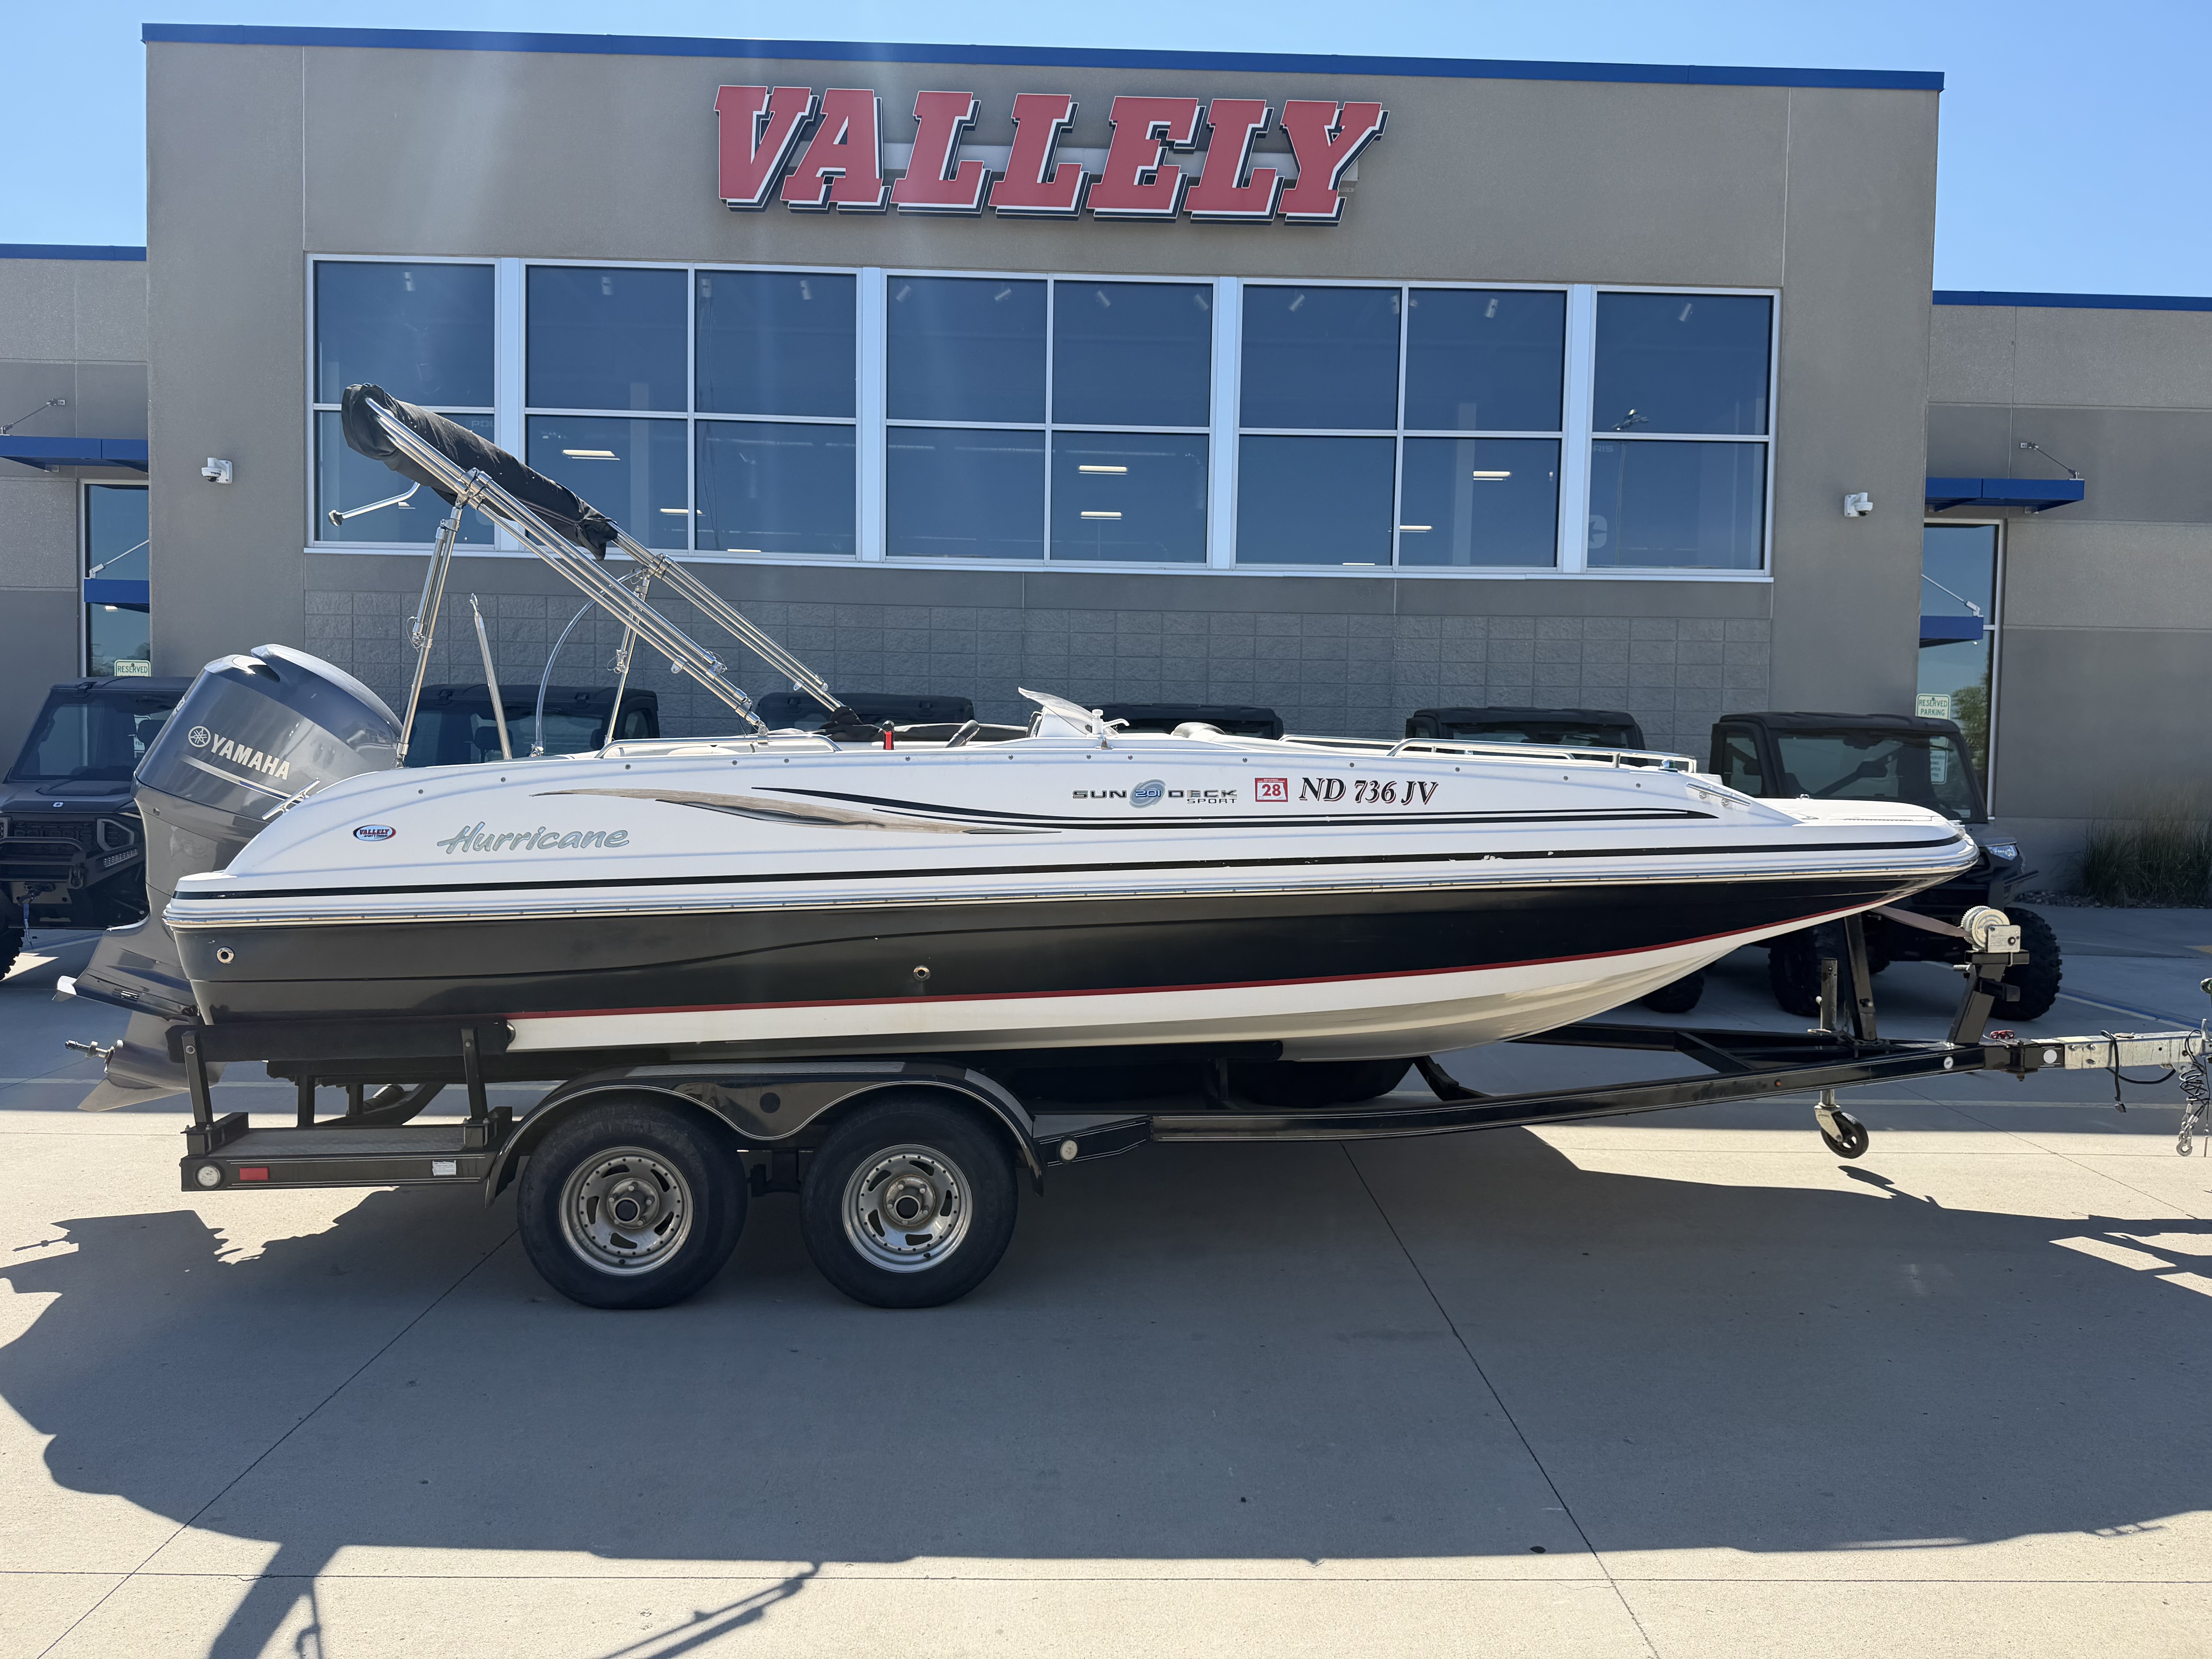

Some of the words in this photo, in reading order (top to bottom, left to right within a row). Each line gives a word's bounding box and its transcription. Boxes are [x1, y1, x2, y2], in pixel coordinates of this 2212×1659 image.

[714, 85, 1388, 222] VALLELY
[211, 733, 290, 780] YAMAHA
[1072, 790, 1127, 799] SUN
[1135, 789, 1161, 798] 201
[1168, 789, 1238, 799] DECK
[1262, 784, 1281, 796] 28
[1298, 777, 1346, 802] ND
[1355, 780, 1397, 804] 736
[1401, 781, 1439, 805] JV
[436, 821, 629, 854] Hurricane
